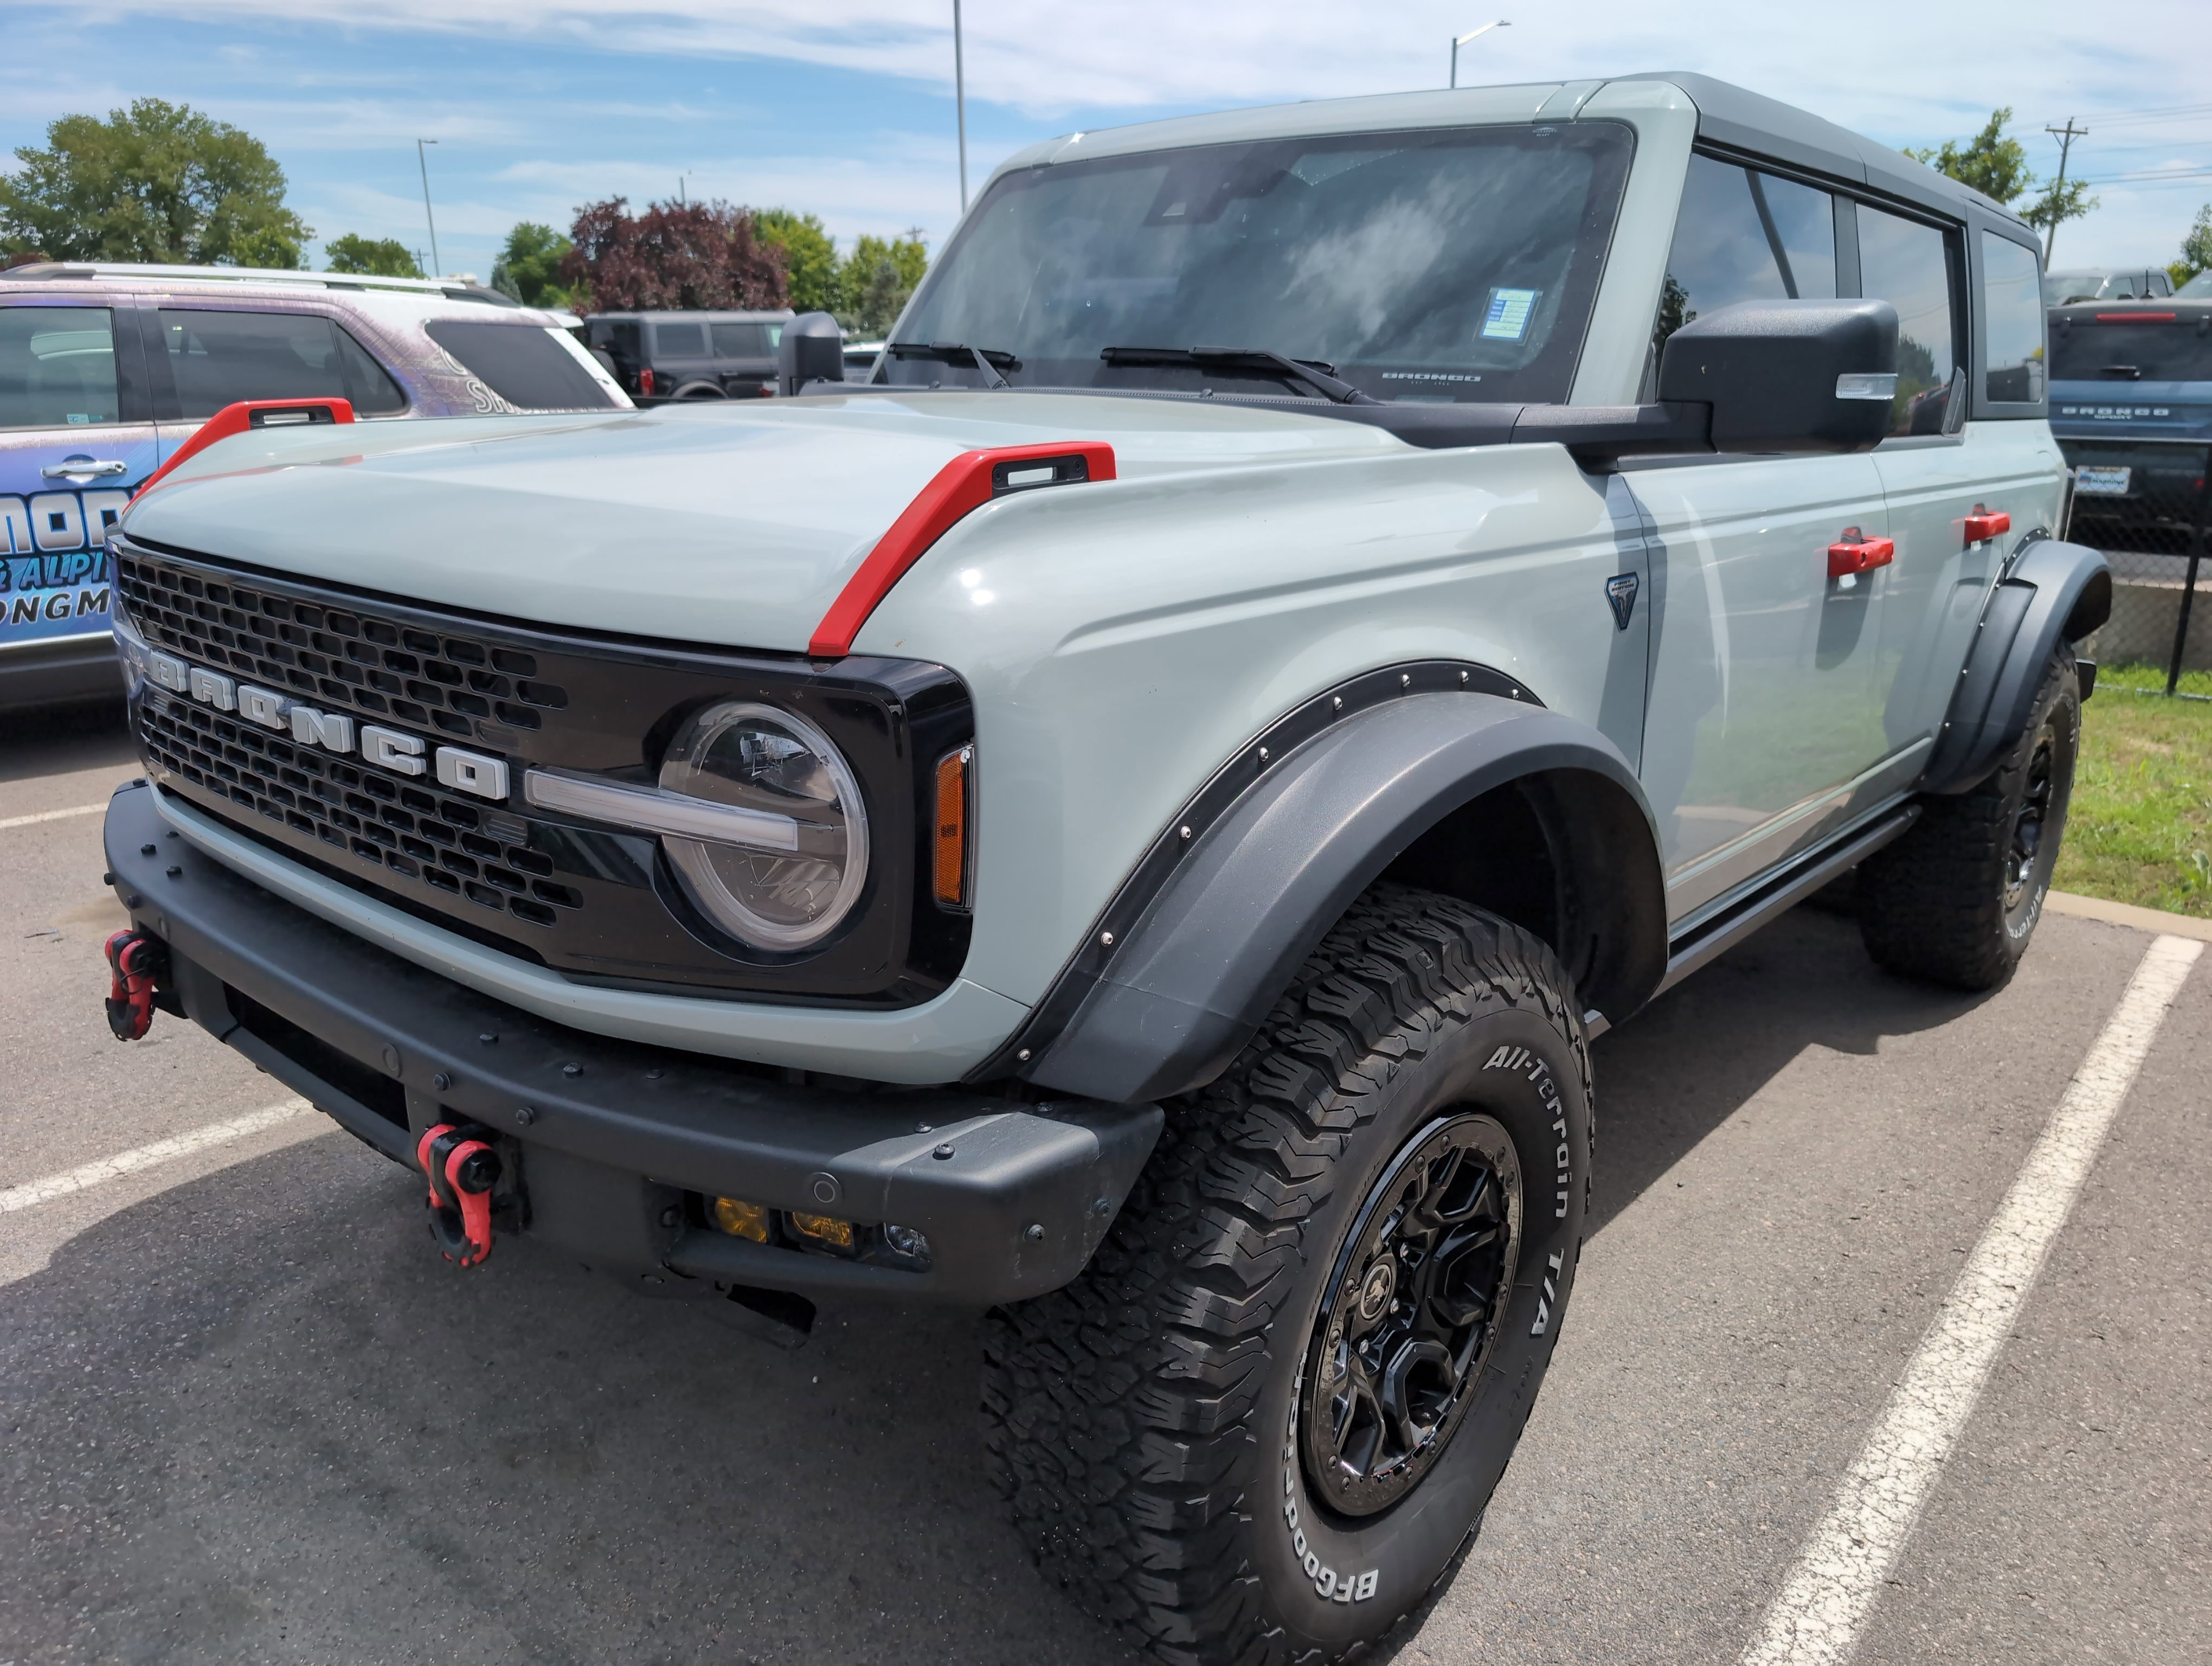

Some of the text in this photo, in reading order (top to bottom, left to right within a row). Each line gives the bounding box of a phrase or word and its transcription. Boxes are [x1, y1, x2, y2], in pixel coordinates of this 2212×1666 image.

[1382, 372, 1481, 382] BRONCO
[2062, 407, 2169, 416] BRONCO
[150, 652, 511, 800] BRONCO
[1531, 1248, 1564, 1335] T/A
